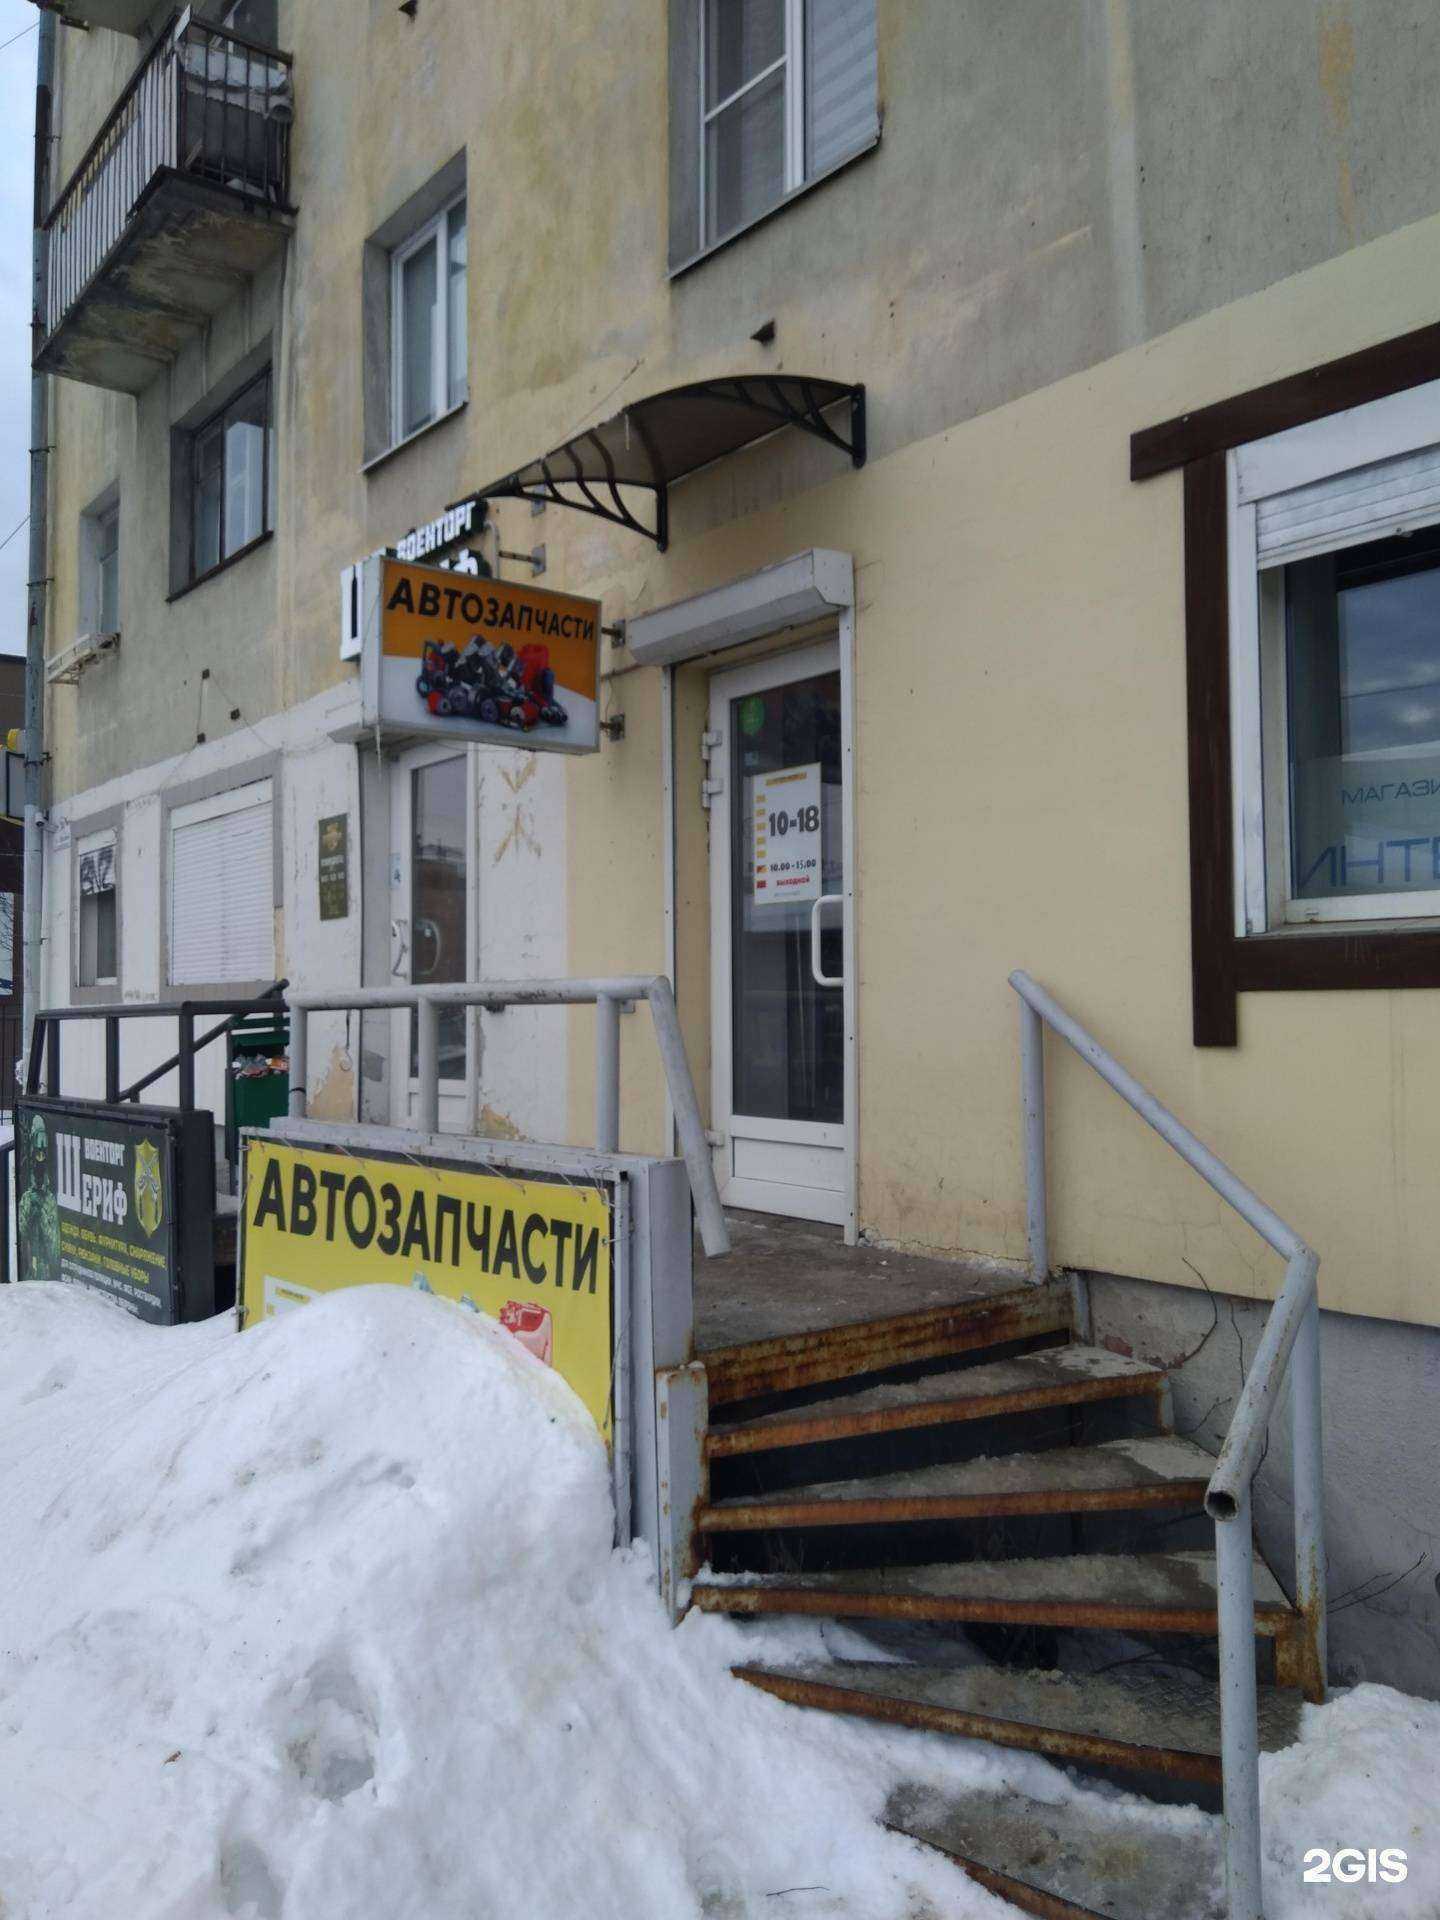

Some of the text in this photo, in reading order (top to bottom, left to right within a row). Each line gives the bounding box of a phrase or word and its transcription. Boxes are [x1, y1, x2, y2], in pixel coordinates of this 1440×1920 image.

[386, 577, 596, 641] АВТОЗАПЧАСТИ
[768, 804, 820, 837] 10-18
[1297, 835, 1440, 888] ИНТ
[252, 1157, 599, 1295] АВТОЗАПЧАСТИ
